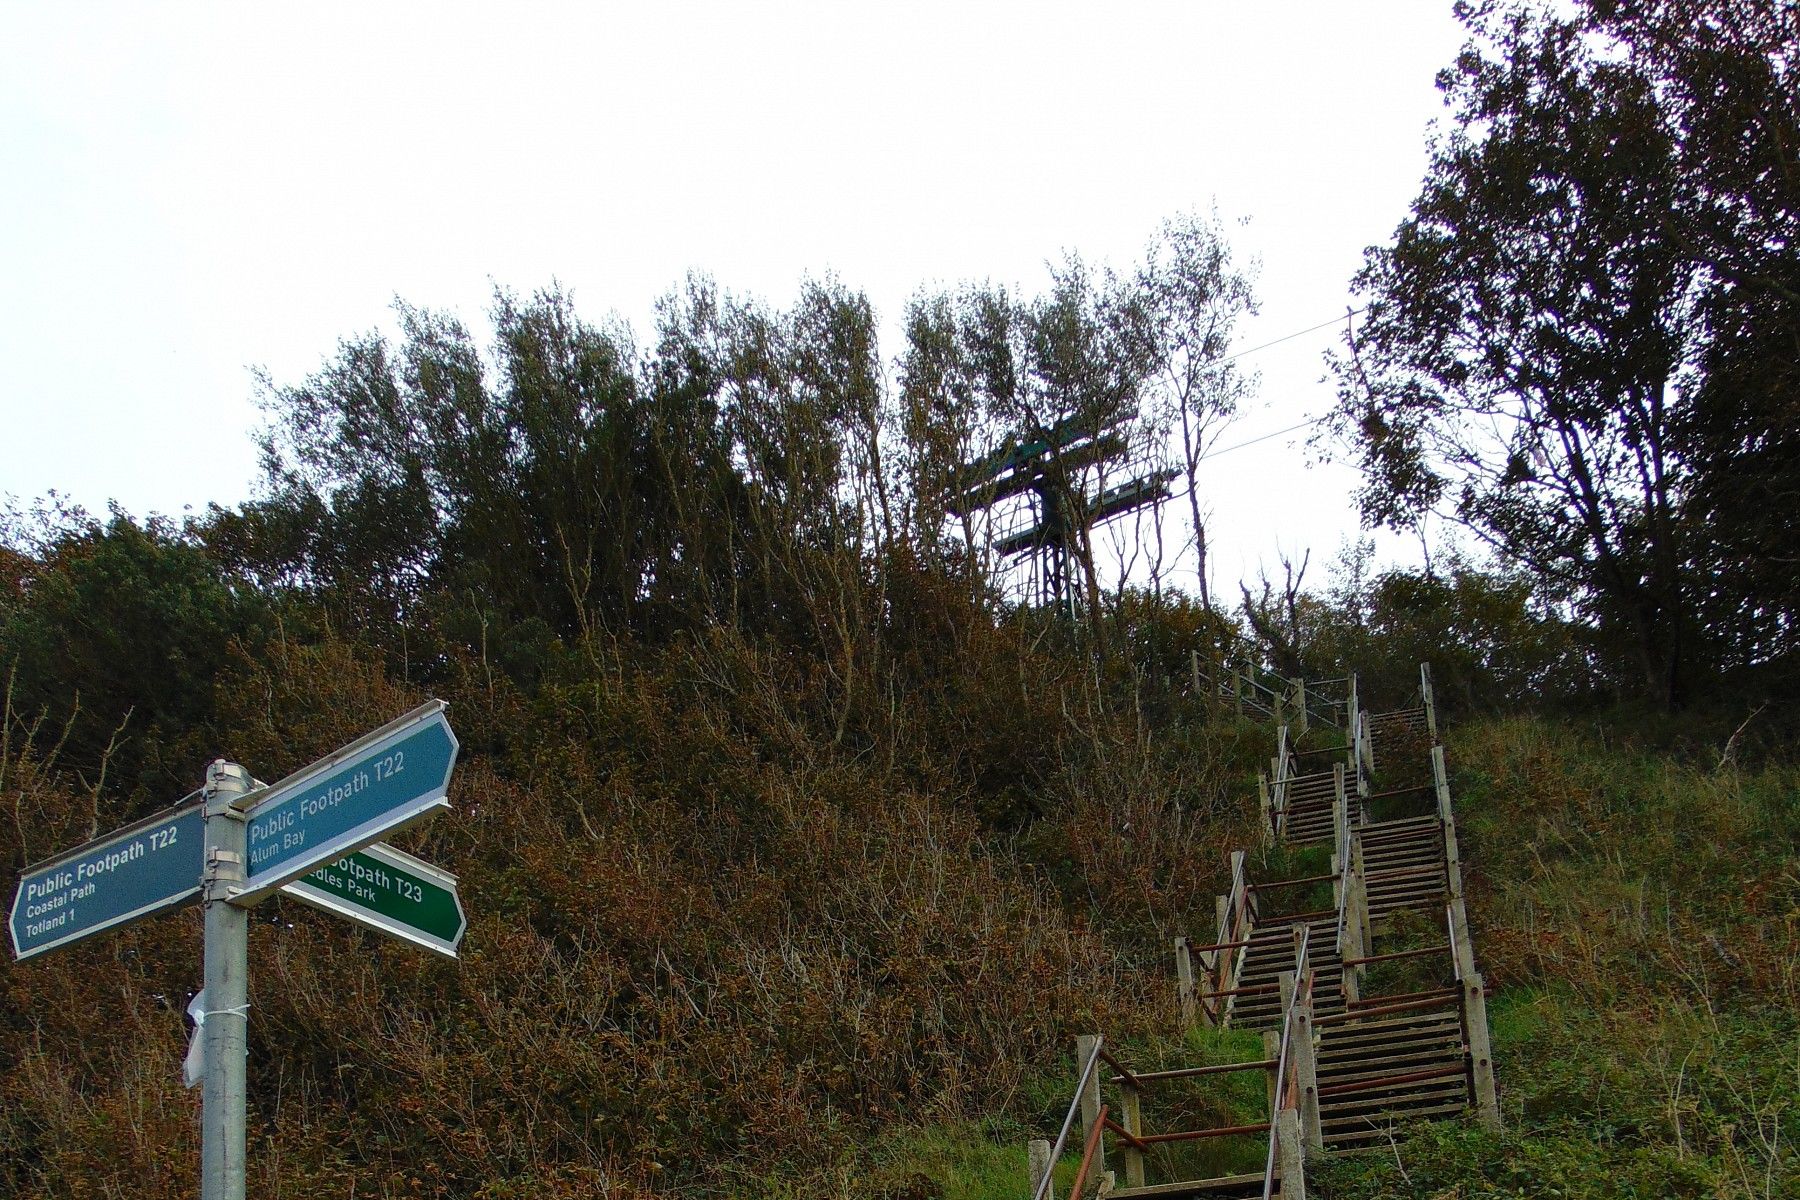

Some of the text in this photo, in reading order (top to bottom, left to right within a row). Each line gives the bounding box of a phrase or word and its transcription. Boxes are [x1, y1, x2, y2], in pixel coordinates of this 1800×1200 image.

[251, 751, 404, 844] Public Footpath T22
[27, 826, 178, 901] Public Footpath T22
[250, 829, 305, 866] Alum Bay
[26, 882, 96, 918] Coastal Path
[347, 879, 376, 903] Park
[395, 877, 422, 903] T23
[26, 909, 75, 938] Totland 1
